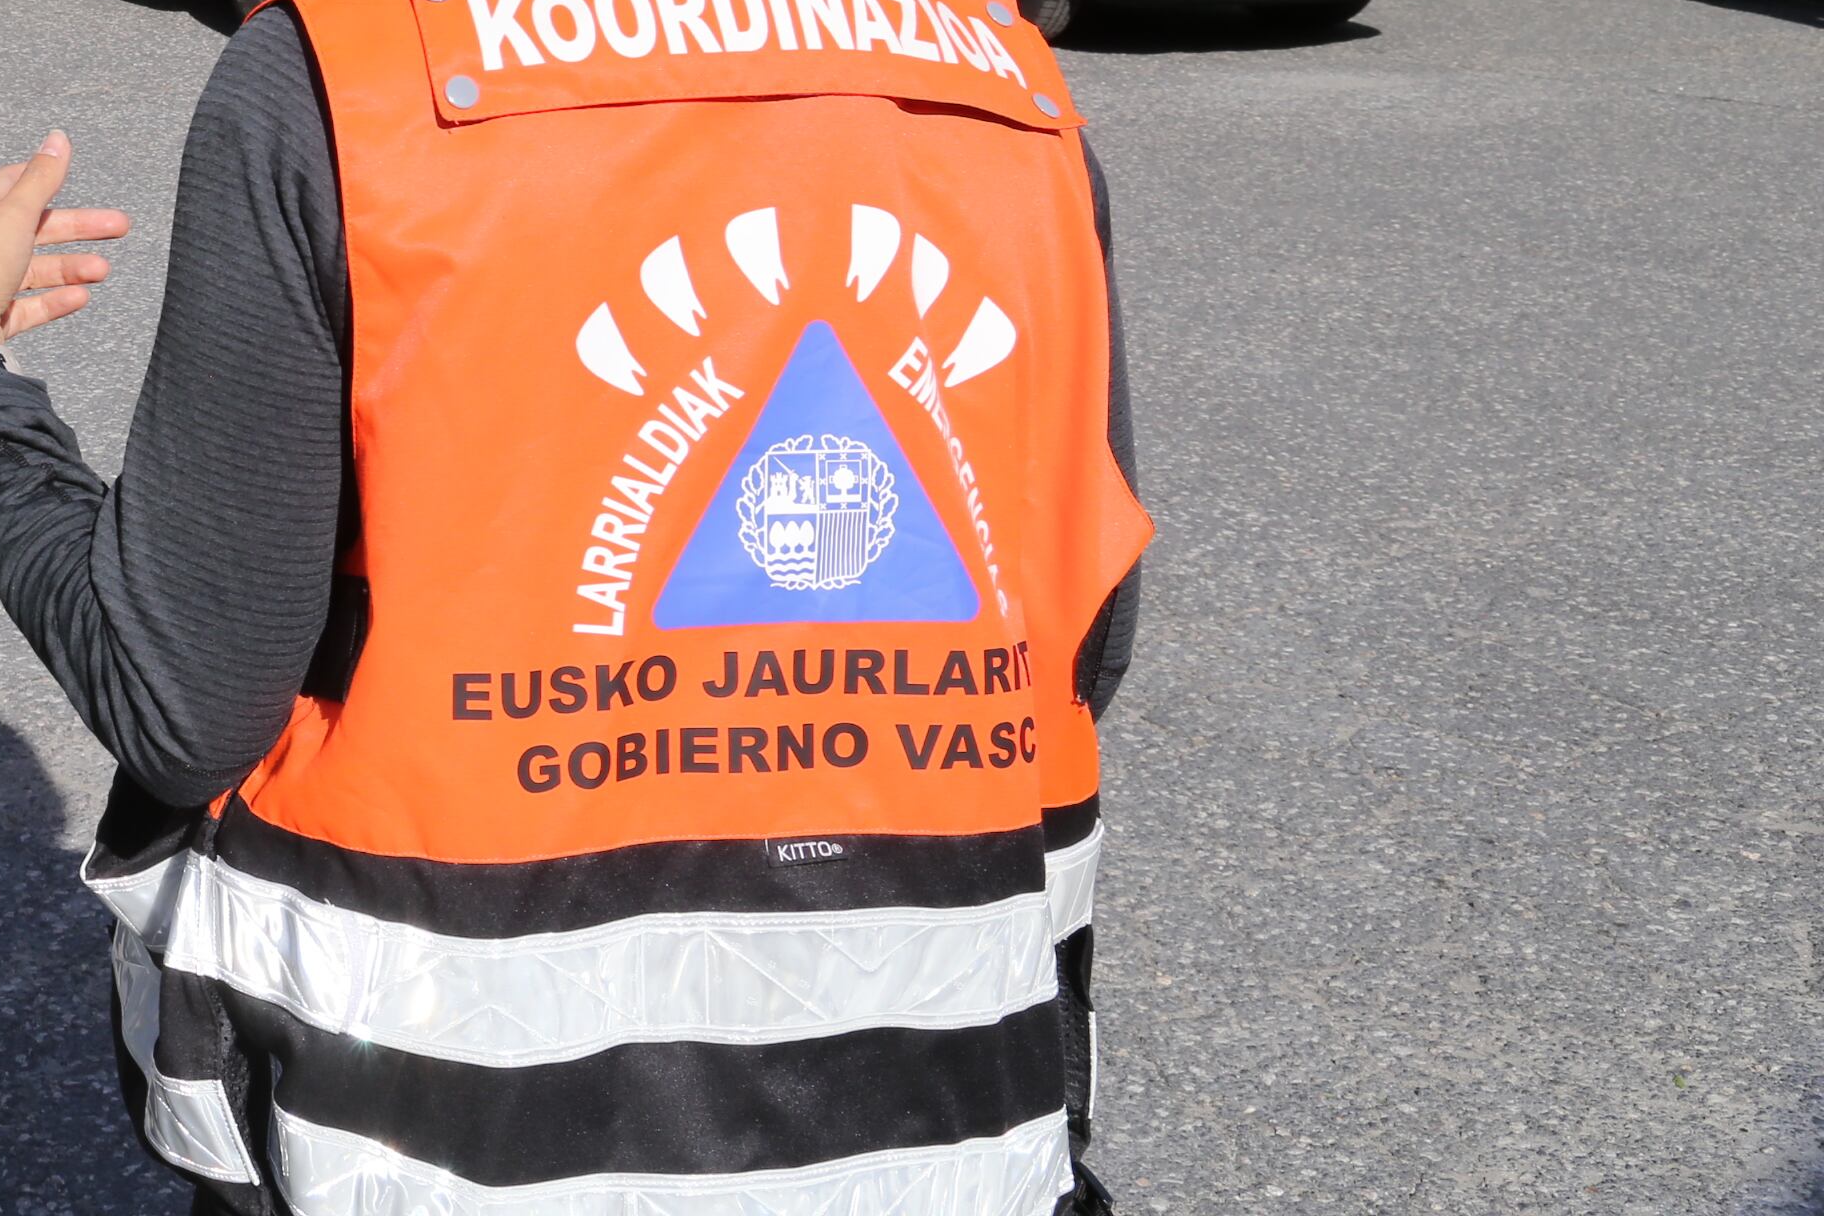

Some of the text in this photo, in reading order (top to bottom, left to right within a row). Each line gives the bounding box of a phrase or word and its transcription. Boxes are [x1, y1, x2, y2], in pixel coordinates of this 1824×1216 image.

[572, 355, 746, 637] LARRIALDIAK
[451, 640, 1033, 722] EUSKO JAURLARIT
[516, 715, 1037, 794] GOBIERNO VASC
